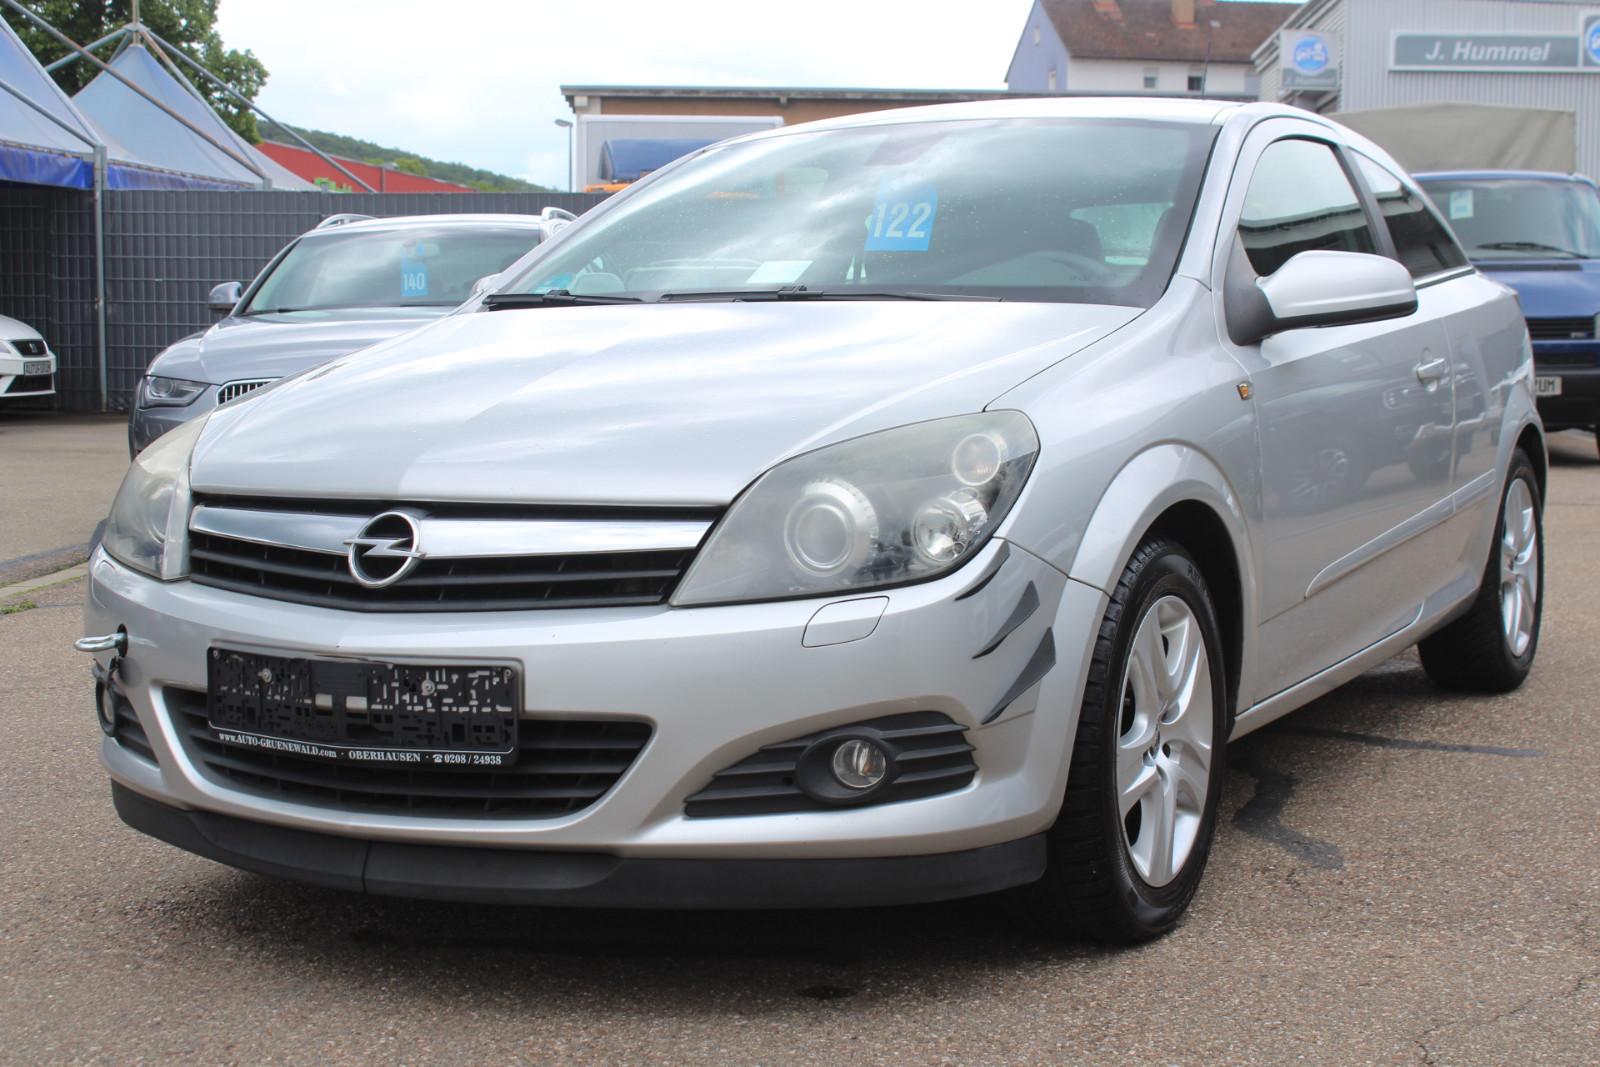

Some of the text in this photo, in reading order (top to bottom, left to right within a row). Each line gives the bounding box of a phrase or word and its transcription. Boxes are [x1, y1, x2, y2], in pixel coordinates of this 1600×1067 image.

[1425, 41, 1551, 61] J. Hummel
[873, 203, 932, 238] 122
[403, 272, 425, 290] 140
[218, 733, 337, 758] www.AUTO-GRUENEWALD.com
[349, 750, 421, 762] OBERHAUSEN
